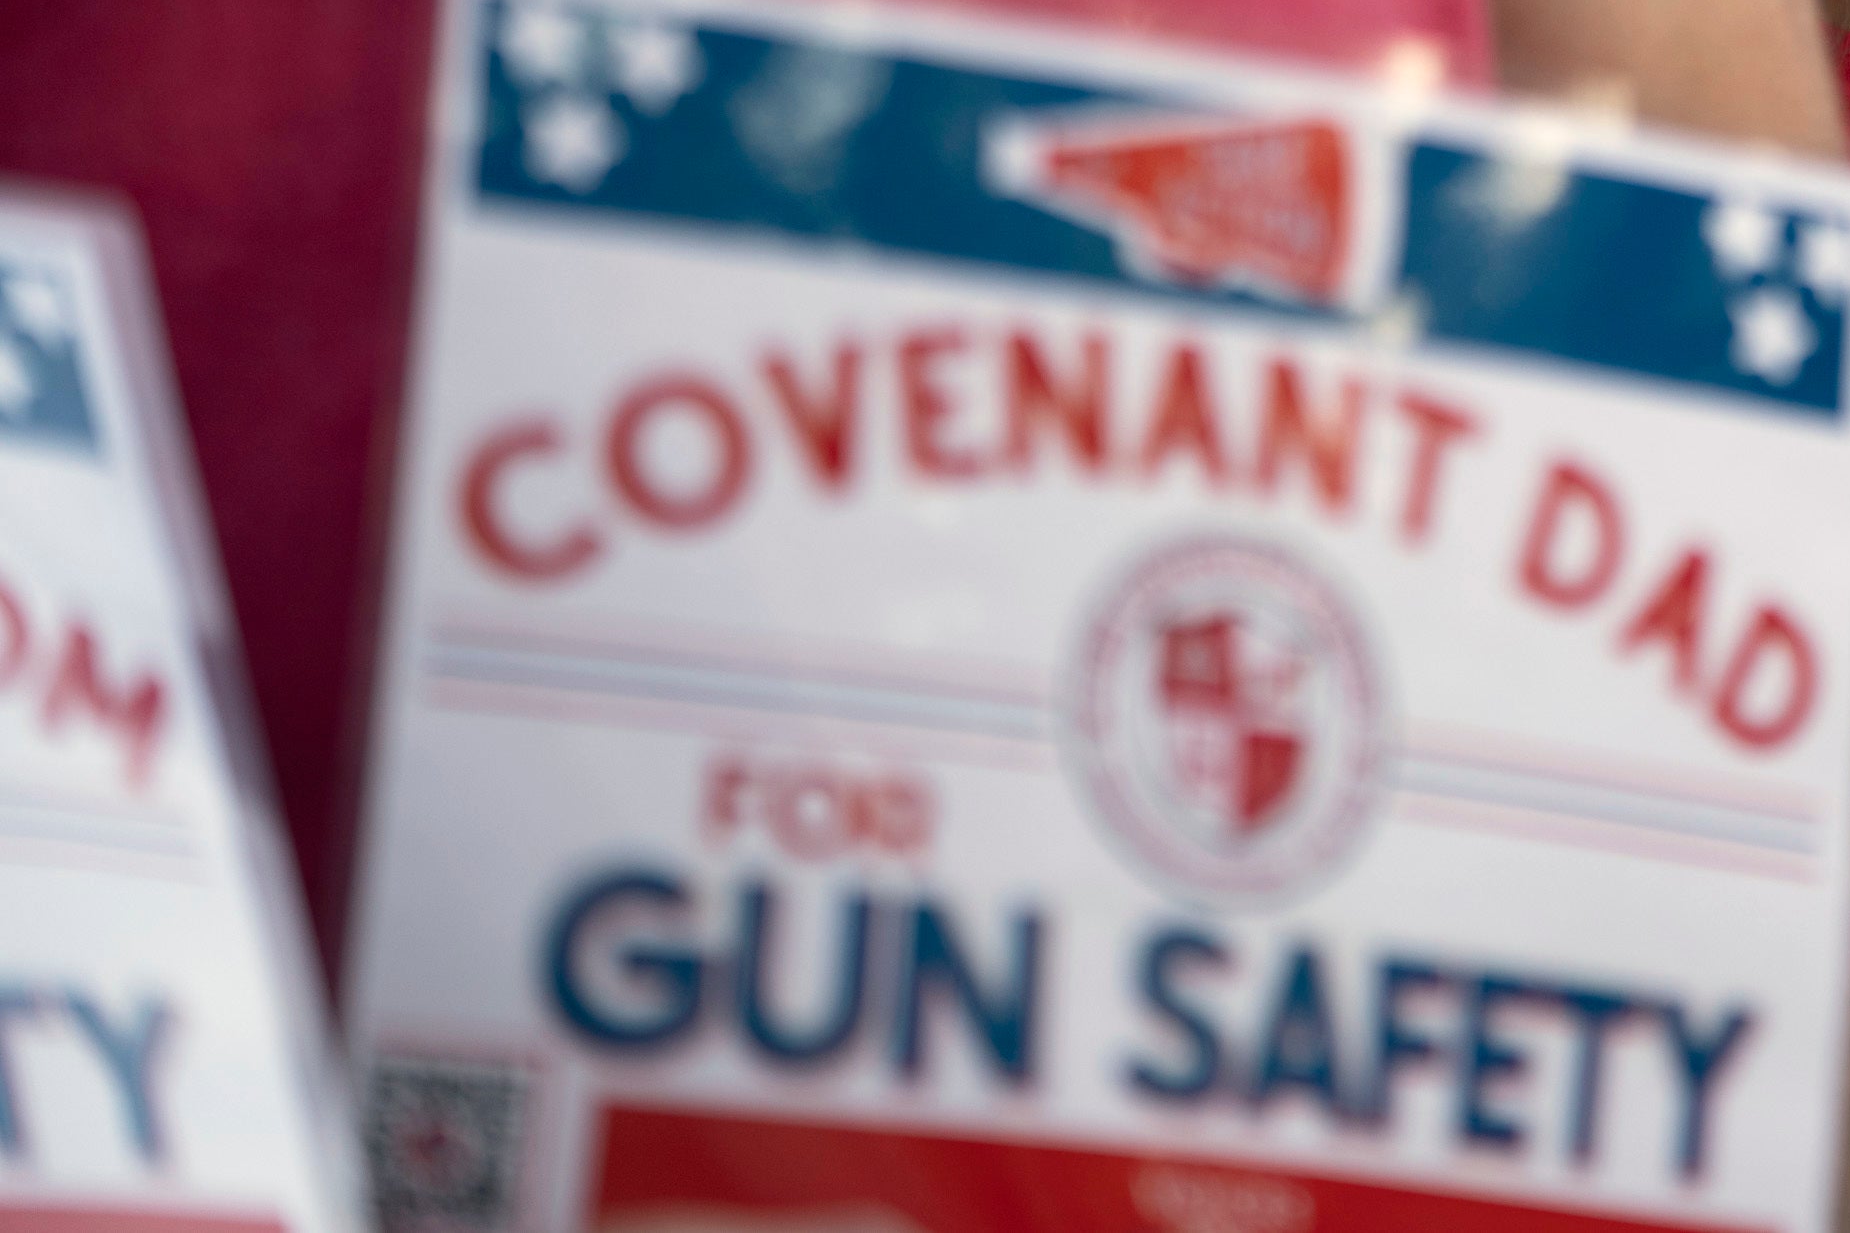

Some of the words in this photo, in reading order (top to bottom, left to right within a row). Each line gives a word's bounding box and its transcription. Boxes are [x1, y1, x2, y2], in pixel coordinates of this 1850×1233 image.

[454, 323, 1484, 584] COVENANT
[1513, 454, 1822, 756] DAD
[700, 748, 935, 863] FOR
[539, 864, 1051, 1087] GUN
[1125, 926, 1760, 1184] SAFETY
